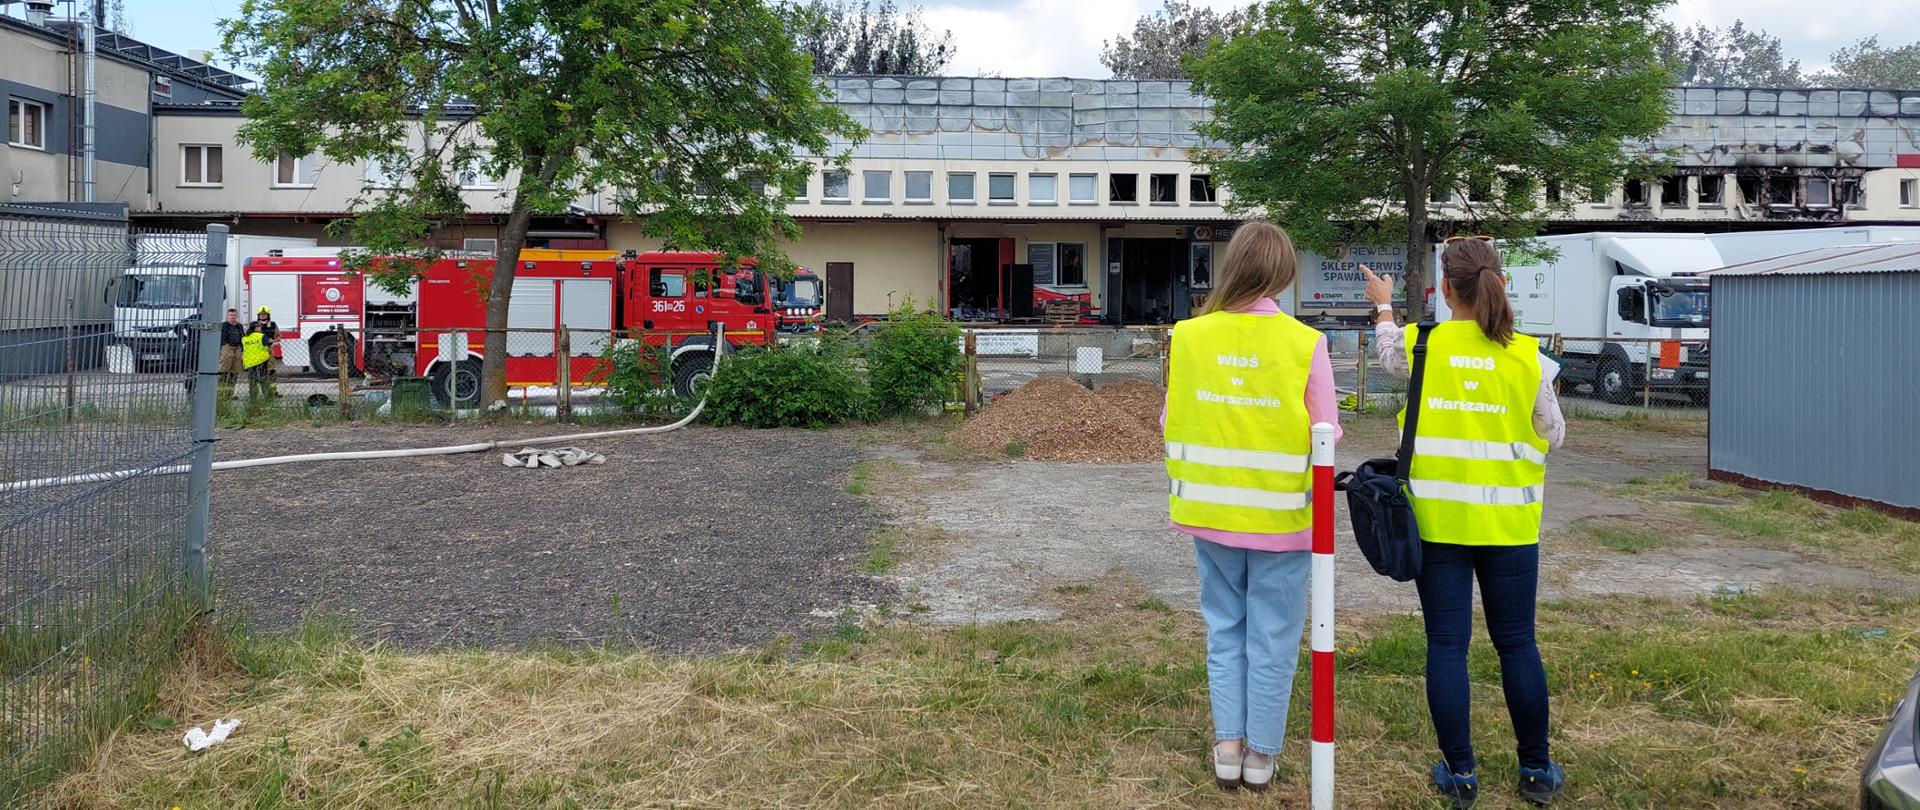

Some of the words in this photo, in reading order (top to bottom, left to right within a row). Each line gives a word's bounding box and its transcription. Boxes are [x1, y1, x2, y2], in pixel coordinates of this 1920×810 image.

[1349, 247, 1401, 256] REWELD
[1321, 261, 1355, 271] SKLEP
[1217, 354, 1260, 368] WIOŚ
[1449, 355, 1495, 371] WIOŚ
[1231, 377, 1244, 386] w
[1463, 380, 1479, 390] w
[1197, 390, 1281, 408] Warszawie
